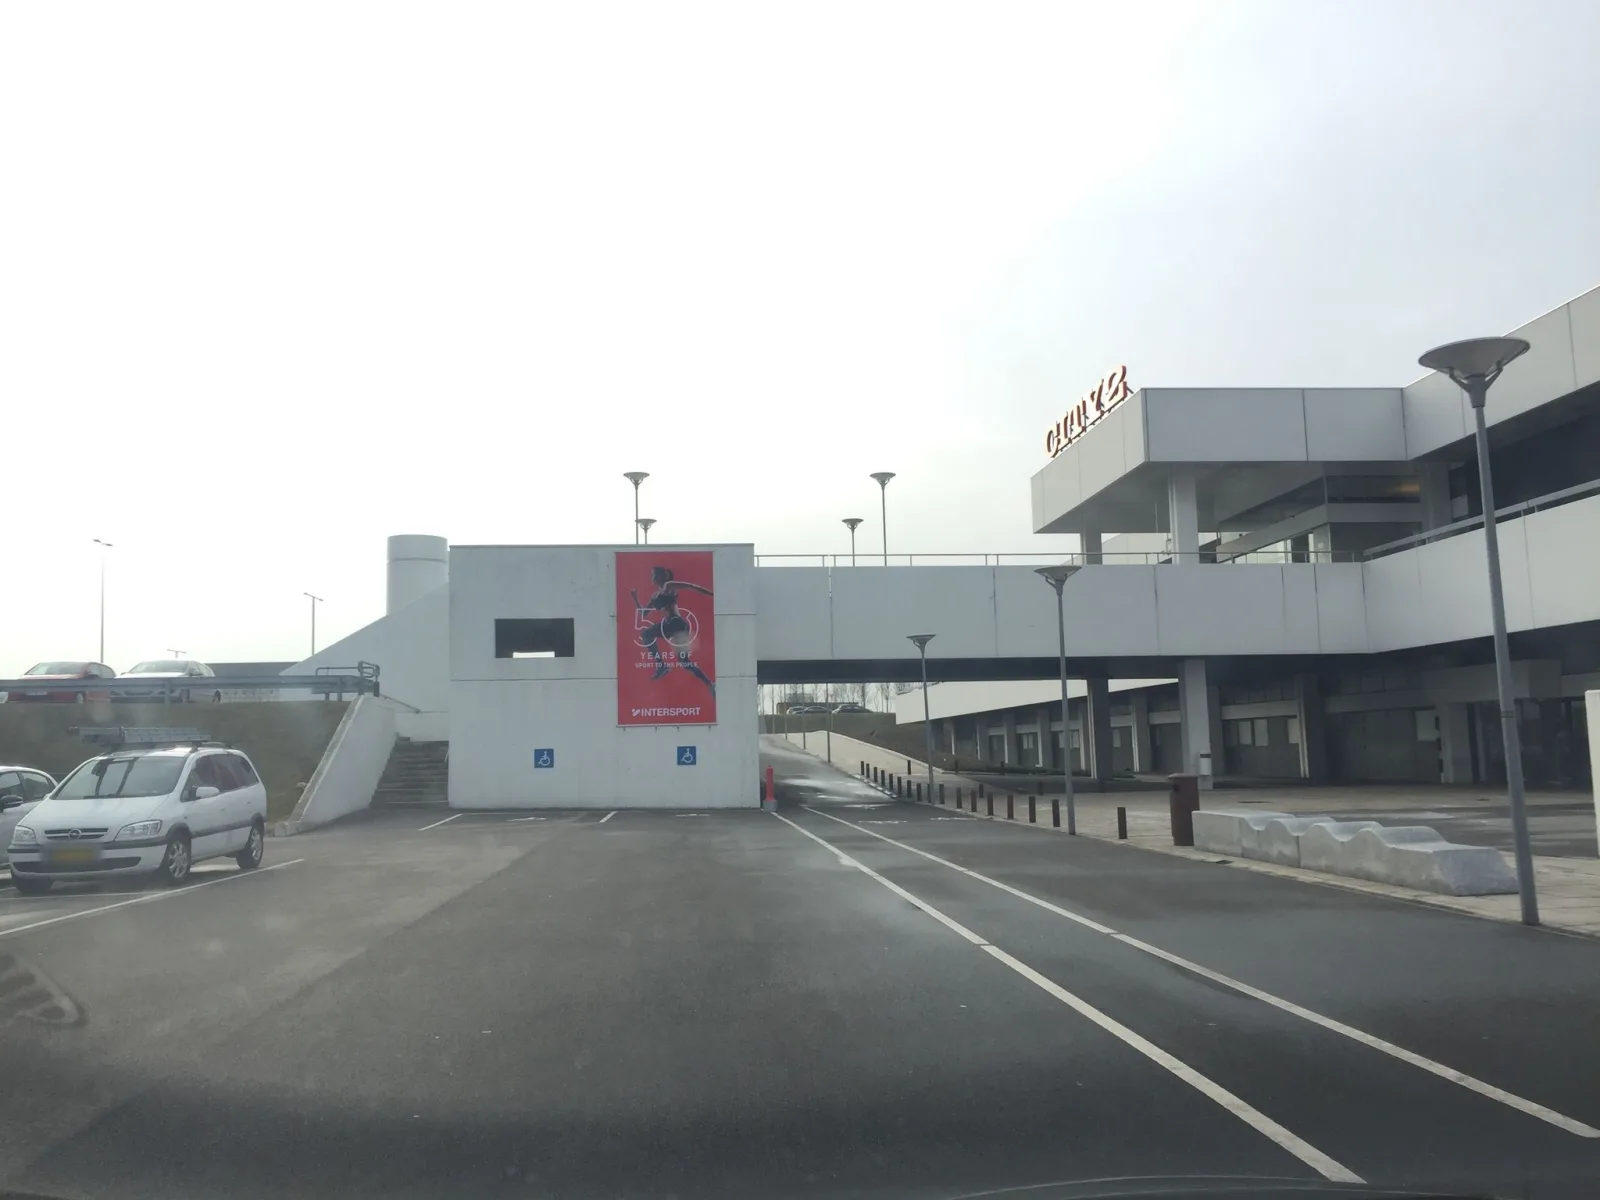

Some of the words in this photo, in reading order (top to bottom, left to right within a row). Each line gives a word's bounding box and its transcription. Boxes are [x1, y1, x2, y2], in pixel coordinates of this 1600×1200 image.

[633, 607, 699, 648] 50
[640, 651, 675, 660] YEARS
[679, 651, 693, 660] OF
[641, 707, 701, 717] INTERSPORT
